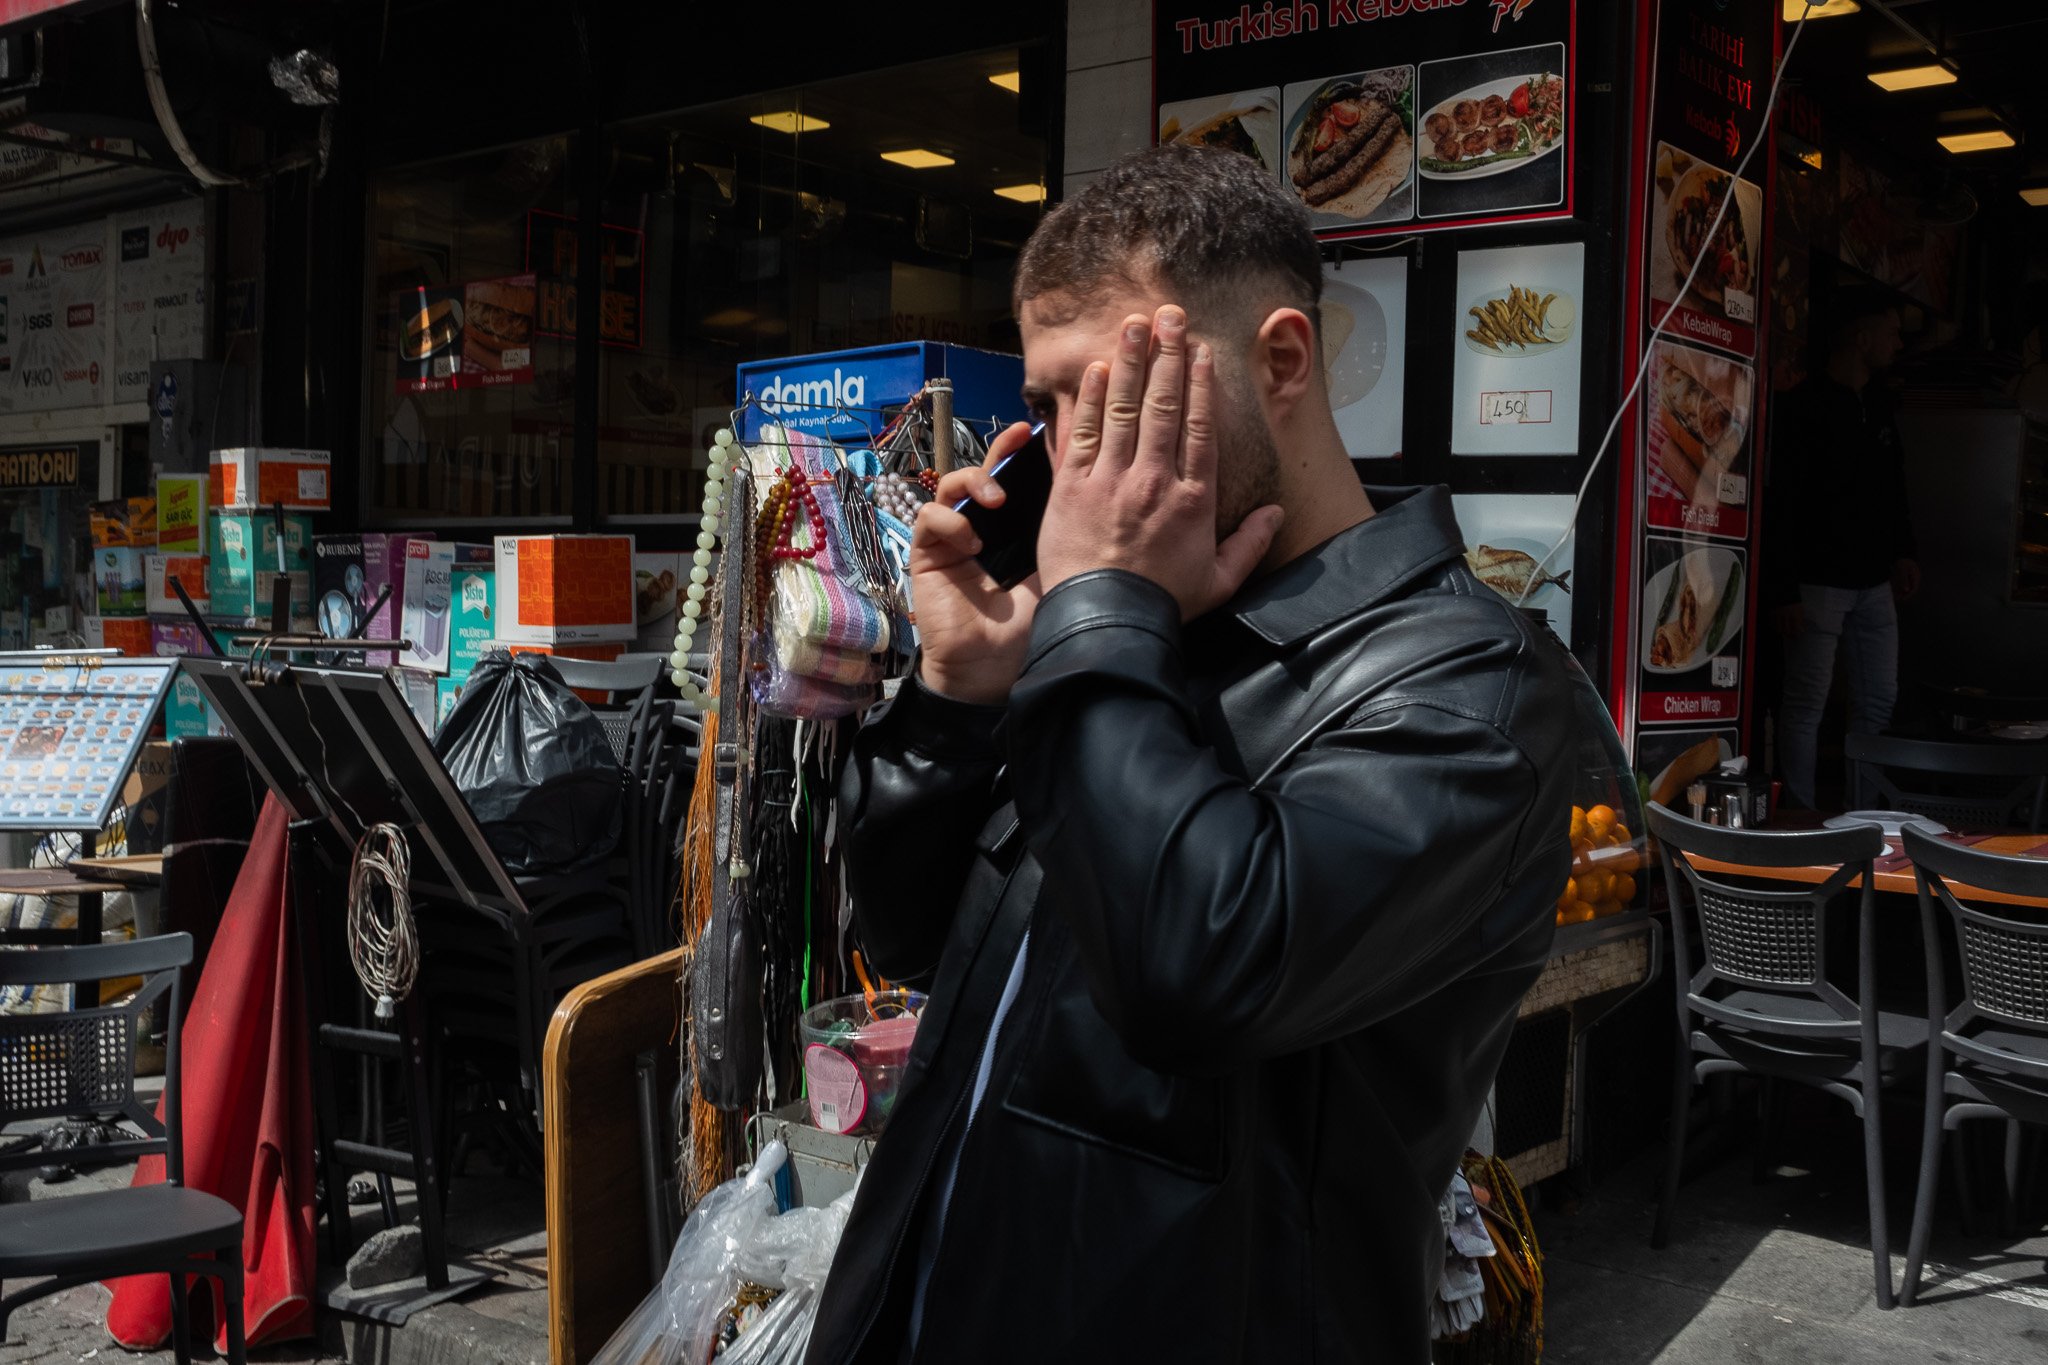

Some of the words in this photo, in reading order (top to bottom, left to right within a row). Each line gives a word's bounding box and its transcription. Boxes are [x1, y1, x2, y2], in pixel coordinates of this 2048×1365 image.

[1176, 1, 1318, 53] Turkish
[1689, 11, 1744, 68] TARİHİ
[1727, 73, 1752, 111] EVİ
[157, 222, 189, 253] dyo
[29, 313, 53, 330] SGS
[1683, 312, 1732, 345] KebabWrap
[495, 374, 513, 383] Bread
[760, 367, 865, 416] damla
[1681, 505, 1697, 523] Fish
[1698, 507, 1719, 527] Bread
[326, 543, 362, 556] RUBENIS
[464, 584, 484, 600] Sista
[1664, 696, 1699, 714] Chicken
[1701, 696, 1721, 716] Wrap
